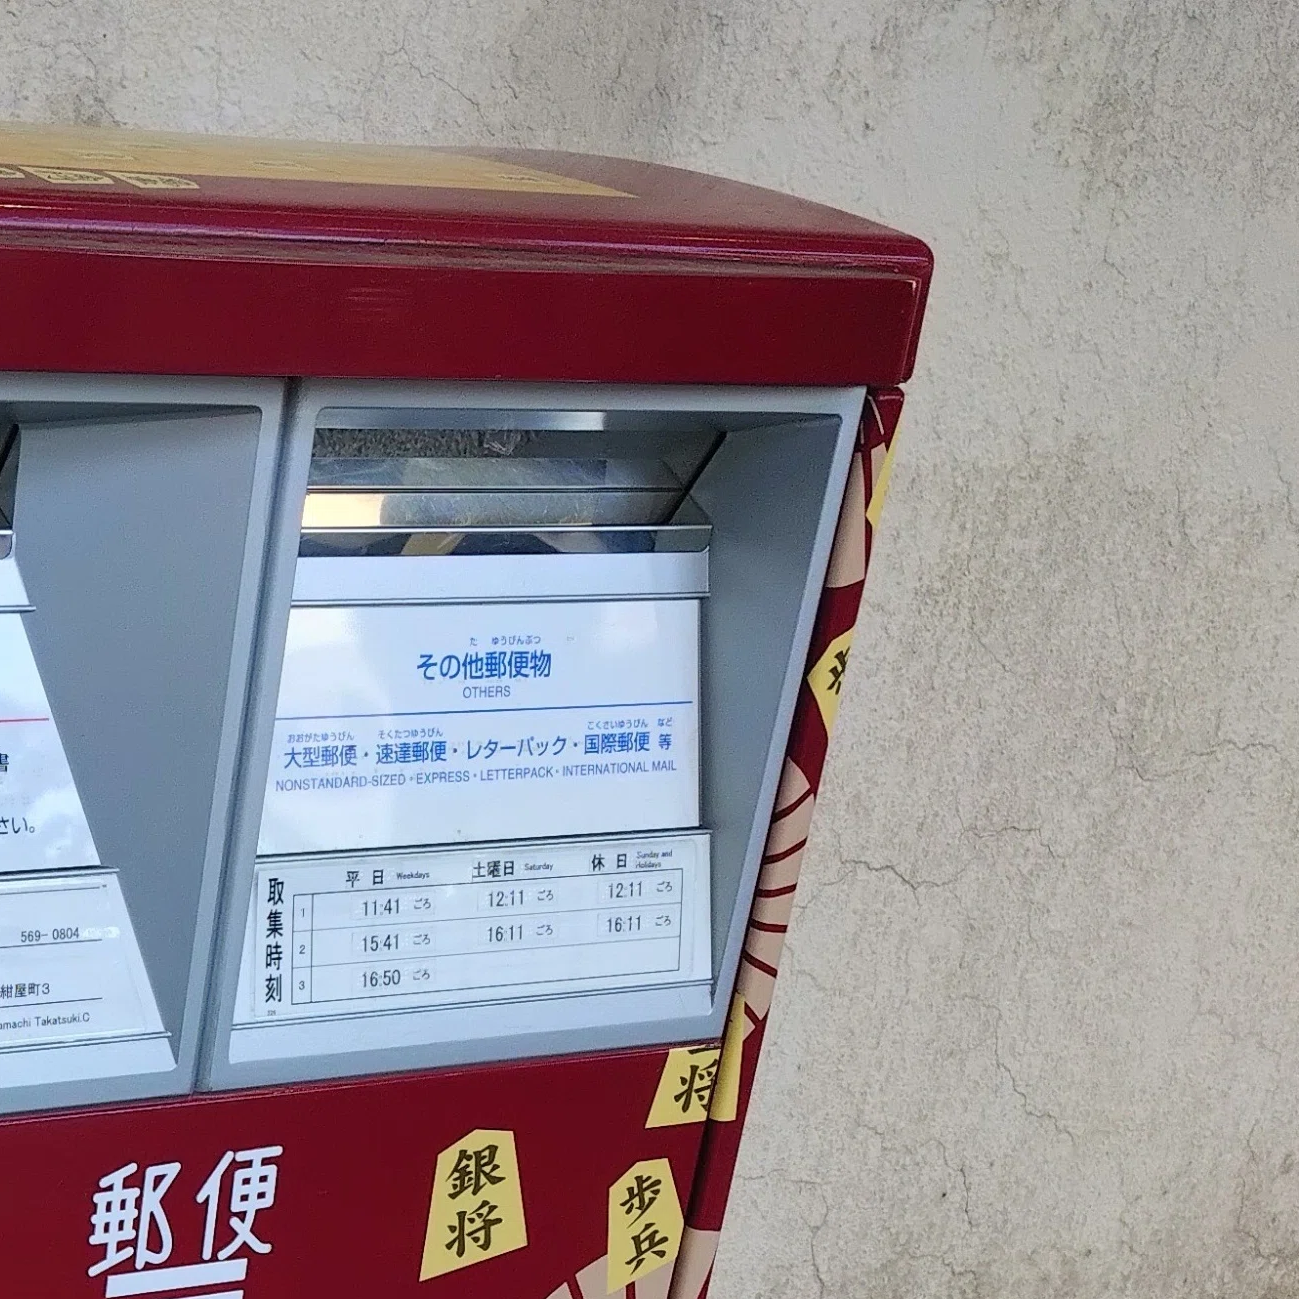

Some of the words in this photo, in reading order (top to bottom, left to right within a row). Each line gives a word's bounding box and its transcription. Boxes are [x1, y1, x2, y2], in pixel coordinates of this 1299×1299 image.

[417, 650, 552, 680] その他郵便物
[462, 686, 511, 699] OTHERS
[275, 774, 406, 792] NONSTANDARD-SIZED
[416, 770, 470, 785] EXPRESS
[480, 765, 554, 781] LETTERPACK
[562, 761, 649, 777] INTERNATIONAL
[652, 760, 677, 772] MAIL
[591, 853, 627, 872] 休日
[636, 851, 660, 860] Sunday
[661, 850, 673, 858] and
[636, 860, 662, 869] Holidays
[396, 871, 430, 880] Weekdays
[472, 860, 515, 879] 土曜日
[524, 863, 553, 872] Saturday
[346, 869, 384, 888] 平日
[362, 898, 401, 916] 11:41
[487, 889, 524, 907] 12:11
[608, 880, 643, 898] 12:11
[265, 877, 285, 1003] 取集時刻
[299, 945, 306, 954] 2
[362, 933, 400, 952] 15:41
[487, 924, 523, 943] 16:11
[607, 915, 642, 933] 16:11
[298, 980, 305, 990] 3
[362, 969, 401, 987] 16:50
[35, 1012, 91, 1027] Takatsuki.C
[87, 1145, 283, 1277] 郵便
[445, 1144, 506, 1258] 銀将
[619, 1174, 669, 1277] 歩兵
